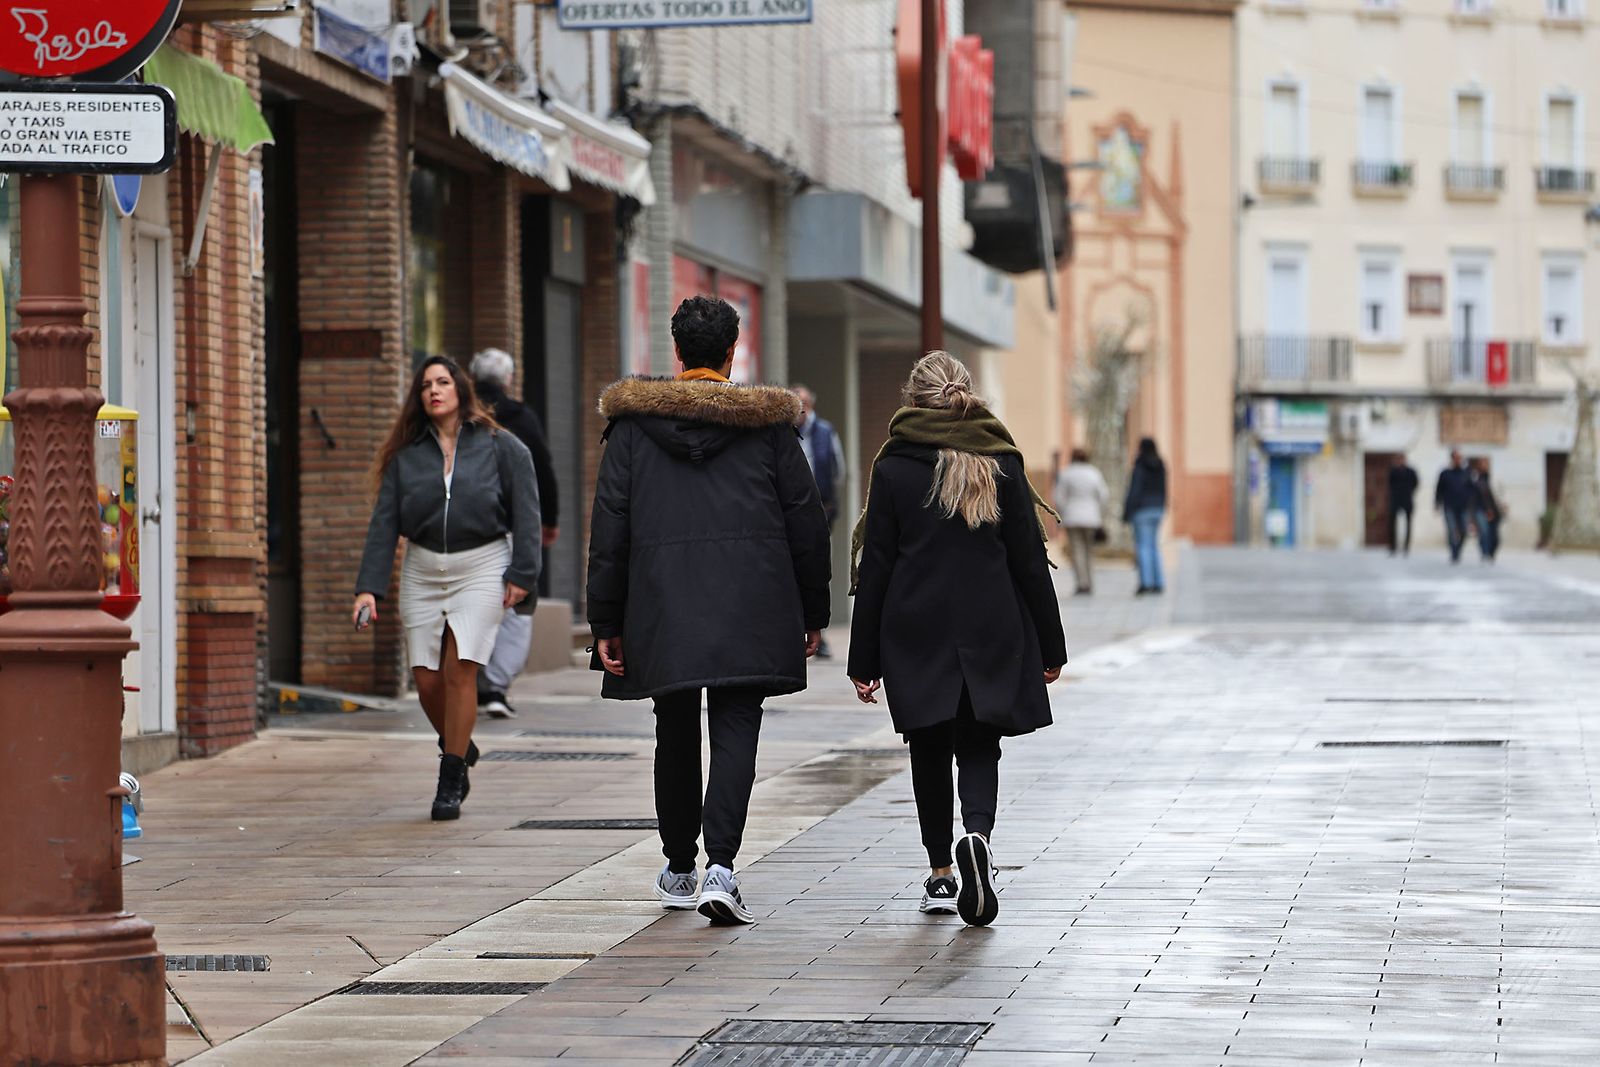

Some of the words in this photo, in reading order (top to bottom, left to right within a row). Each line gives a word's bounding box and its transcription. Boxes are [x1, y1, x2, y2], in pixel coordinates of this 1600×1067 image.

[563, 2, 656, 21] OFERTAS
[662, 0, 723, 19] TODO
[728, 0, 751, 17] EL
[7, 117, 17, 127] Y
[21, 117, 65, 127] TAXIS
[16, 130, 59, 140] GRAN
[64, 130, 89, 141] VIA
[94, 131, 132, 141] ESTE
[38, 143, 57, 154] AL
[62, 144, 128, 155] TRAFICO
